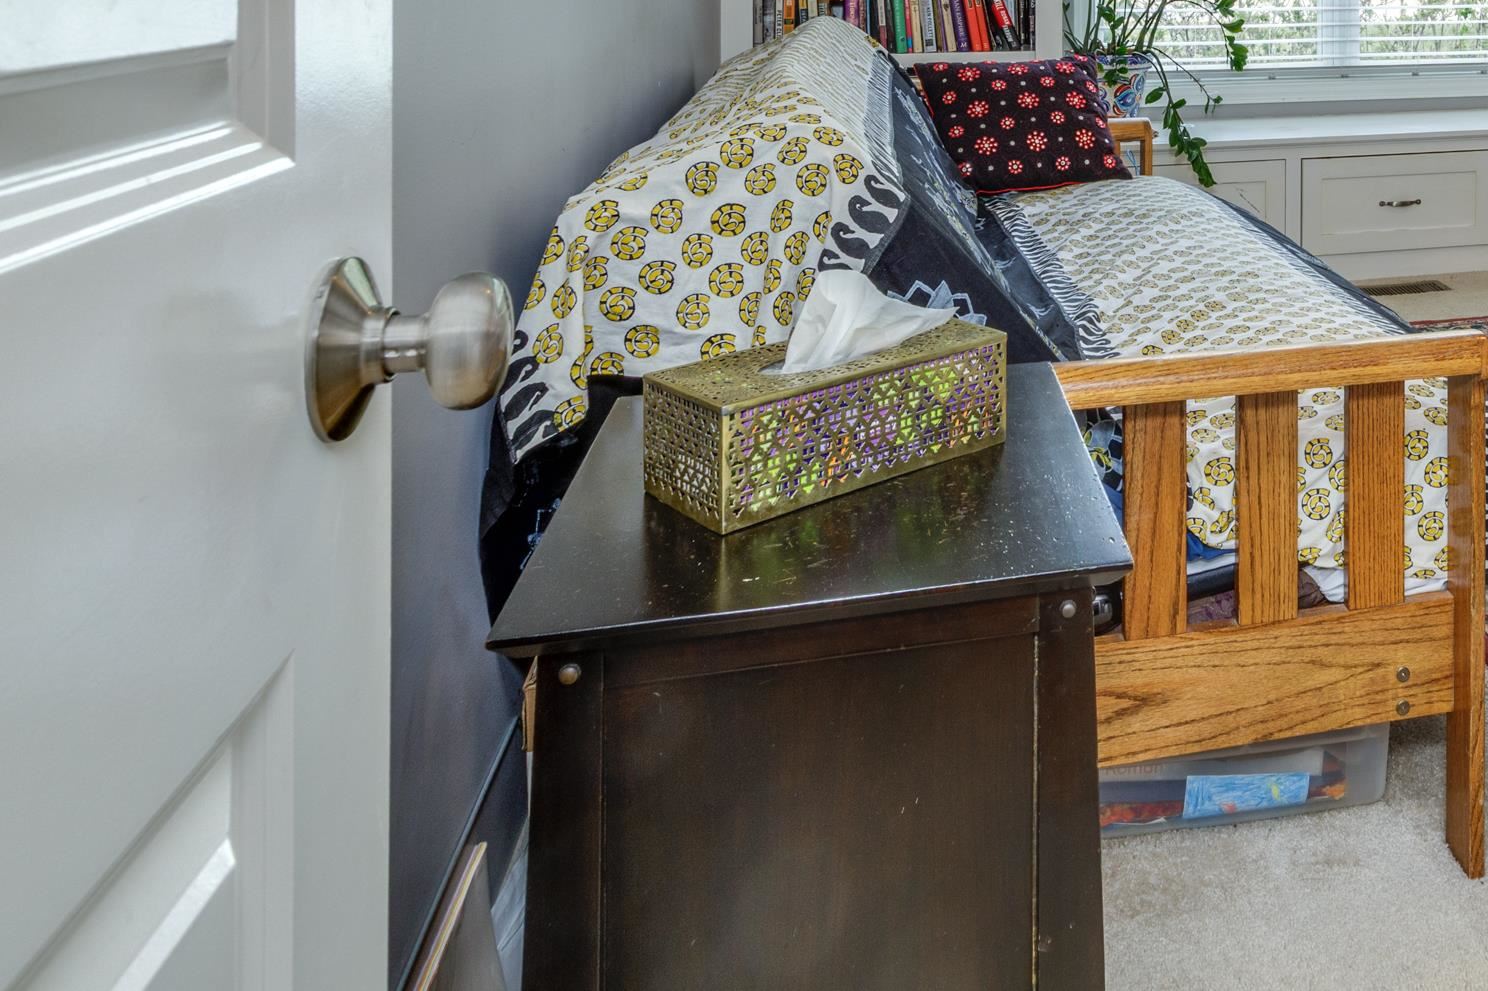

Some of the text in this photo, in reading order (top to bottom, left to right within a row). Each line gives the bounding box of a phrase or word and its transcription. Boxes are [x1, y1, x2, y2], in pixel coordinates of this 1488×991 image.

[993, 0, 1003, 10] KILL
[956, 13, 965, 37] EMPIRE
[1000, 10, 1010, 25] RONAN
[1002, 24, 1013, 42] FARROW
